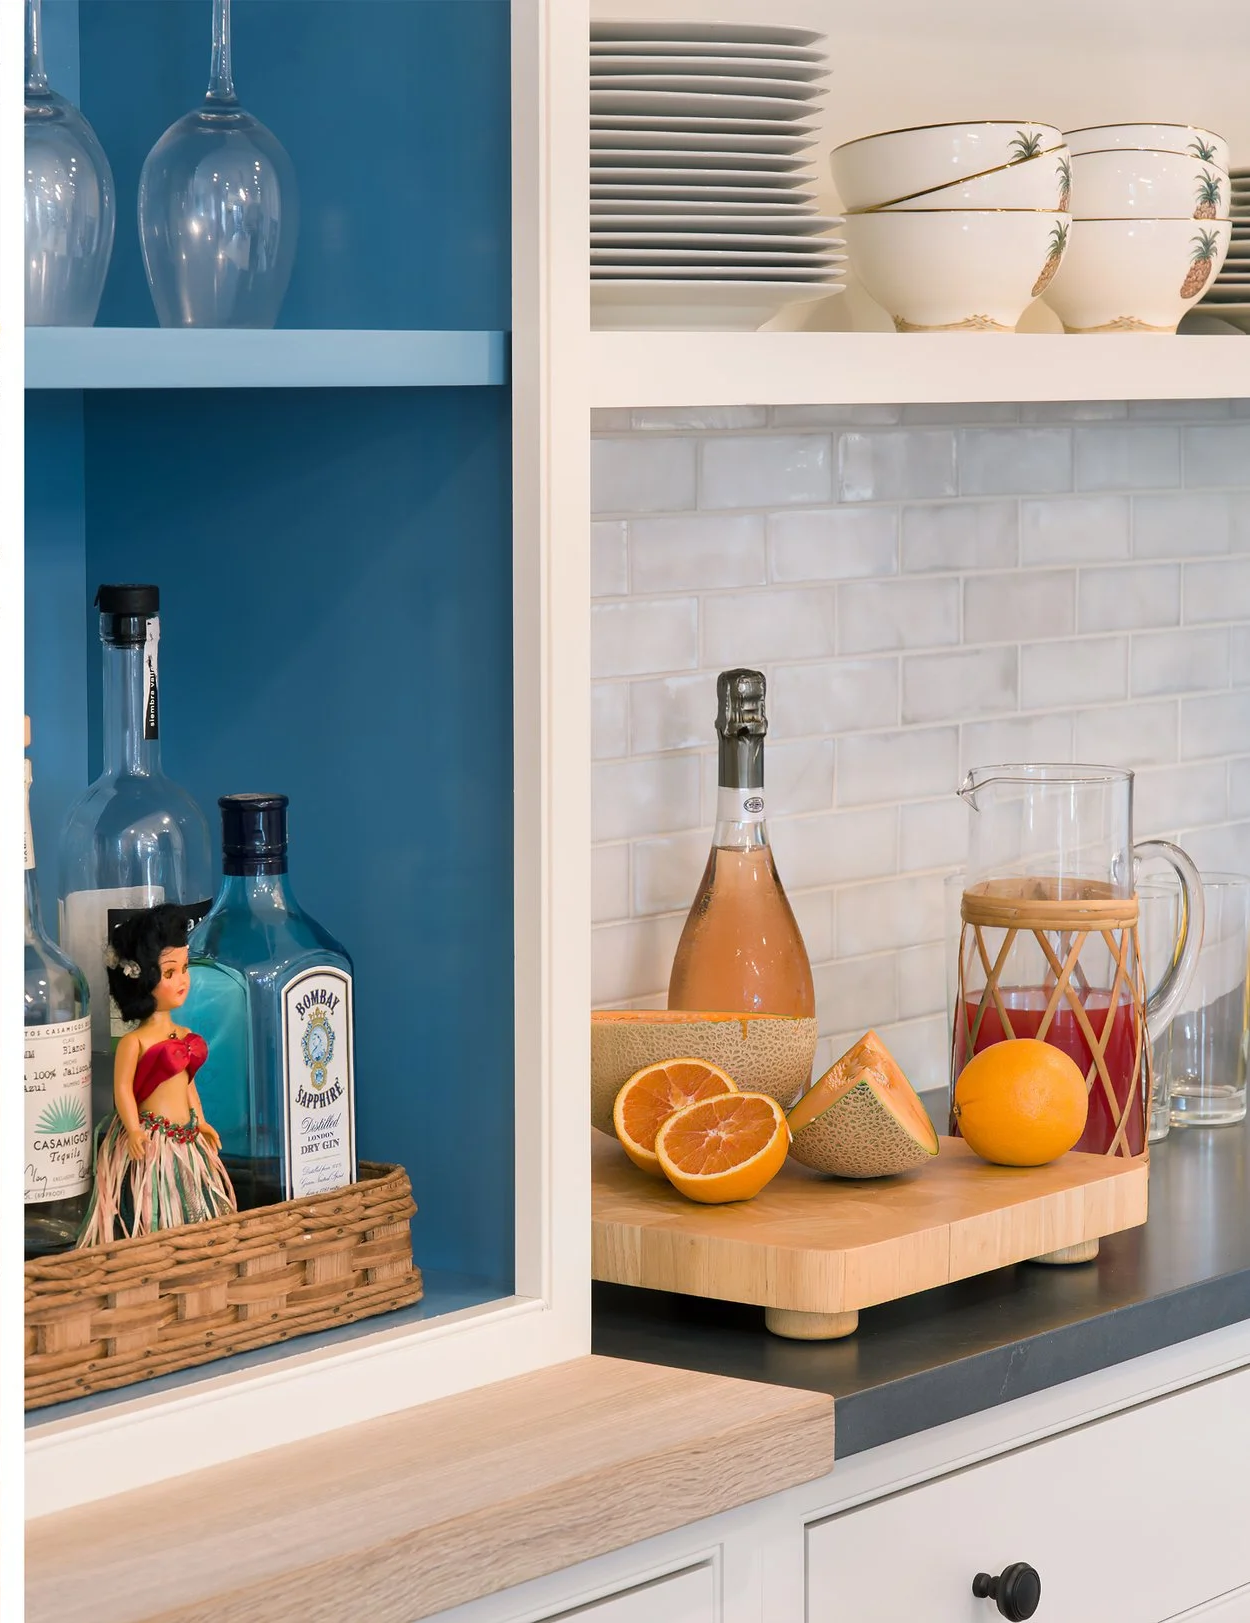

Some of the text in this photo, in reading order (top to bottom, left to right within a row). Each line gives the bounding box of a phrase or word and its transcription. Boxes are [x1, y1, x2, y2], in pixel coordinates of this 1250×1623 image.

[295, 988, 340, 1021] BOMBAY
[45, 1022, 84, 1036] CASAMIGOS
[62, 1044, 86, 1055] Blanco
[34, 1069, 57, 1081] 100%
[295, 1077, 344, 1110] SAPPHIRE
[299, 1112, 342, 1135] Distilled
[33, 1131, 88, 1151] CASAMIGOS
[307, 1130, 335, 1142] LONDON
[50, 1147, 81, 1165] Tequila
[300, 1138, 341, 1156] DRY GIN
